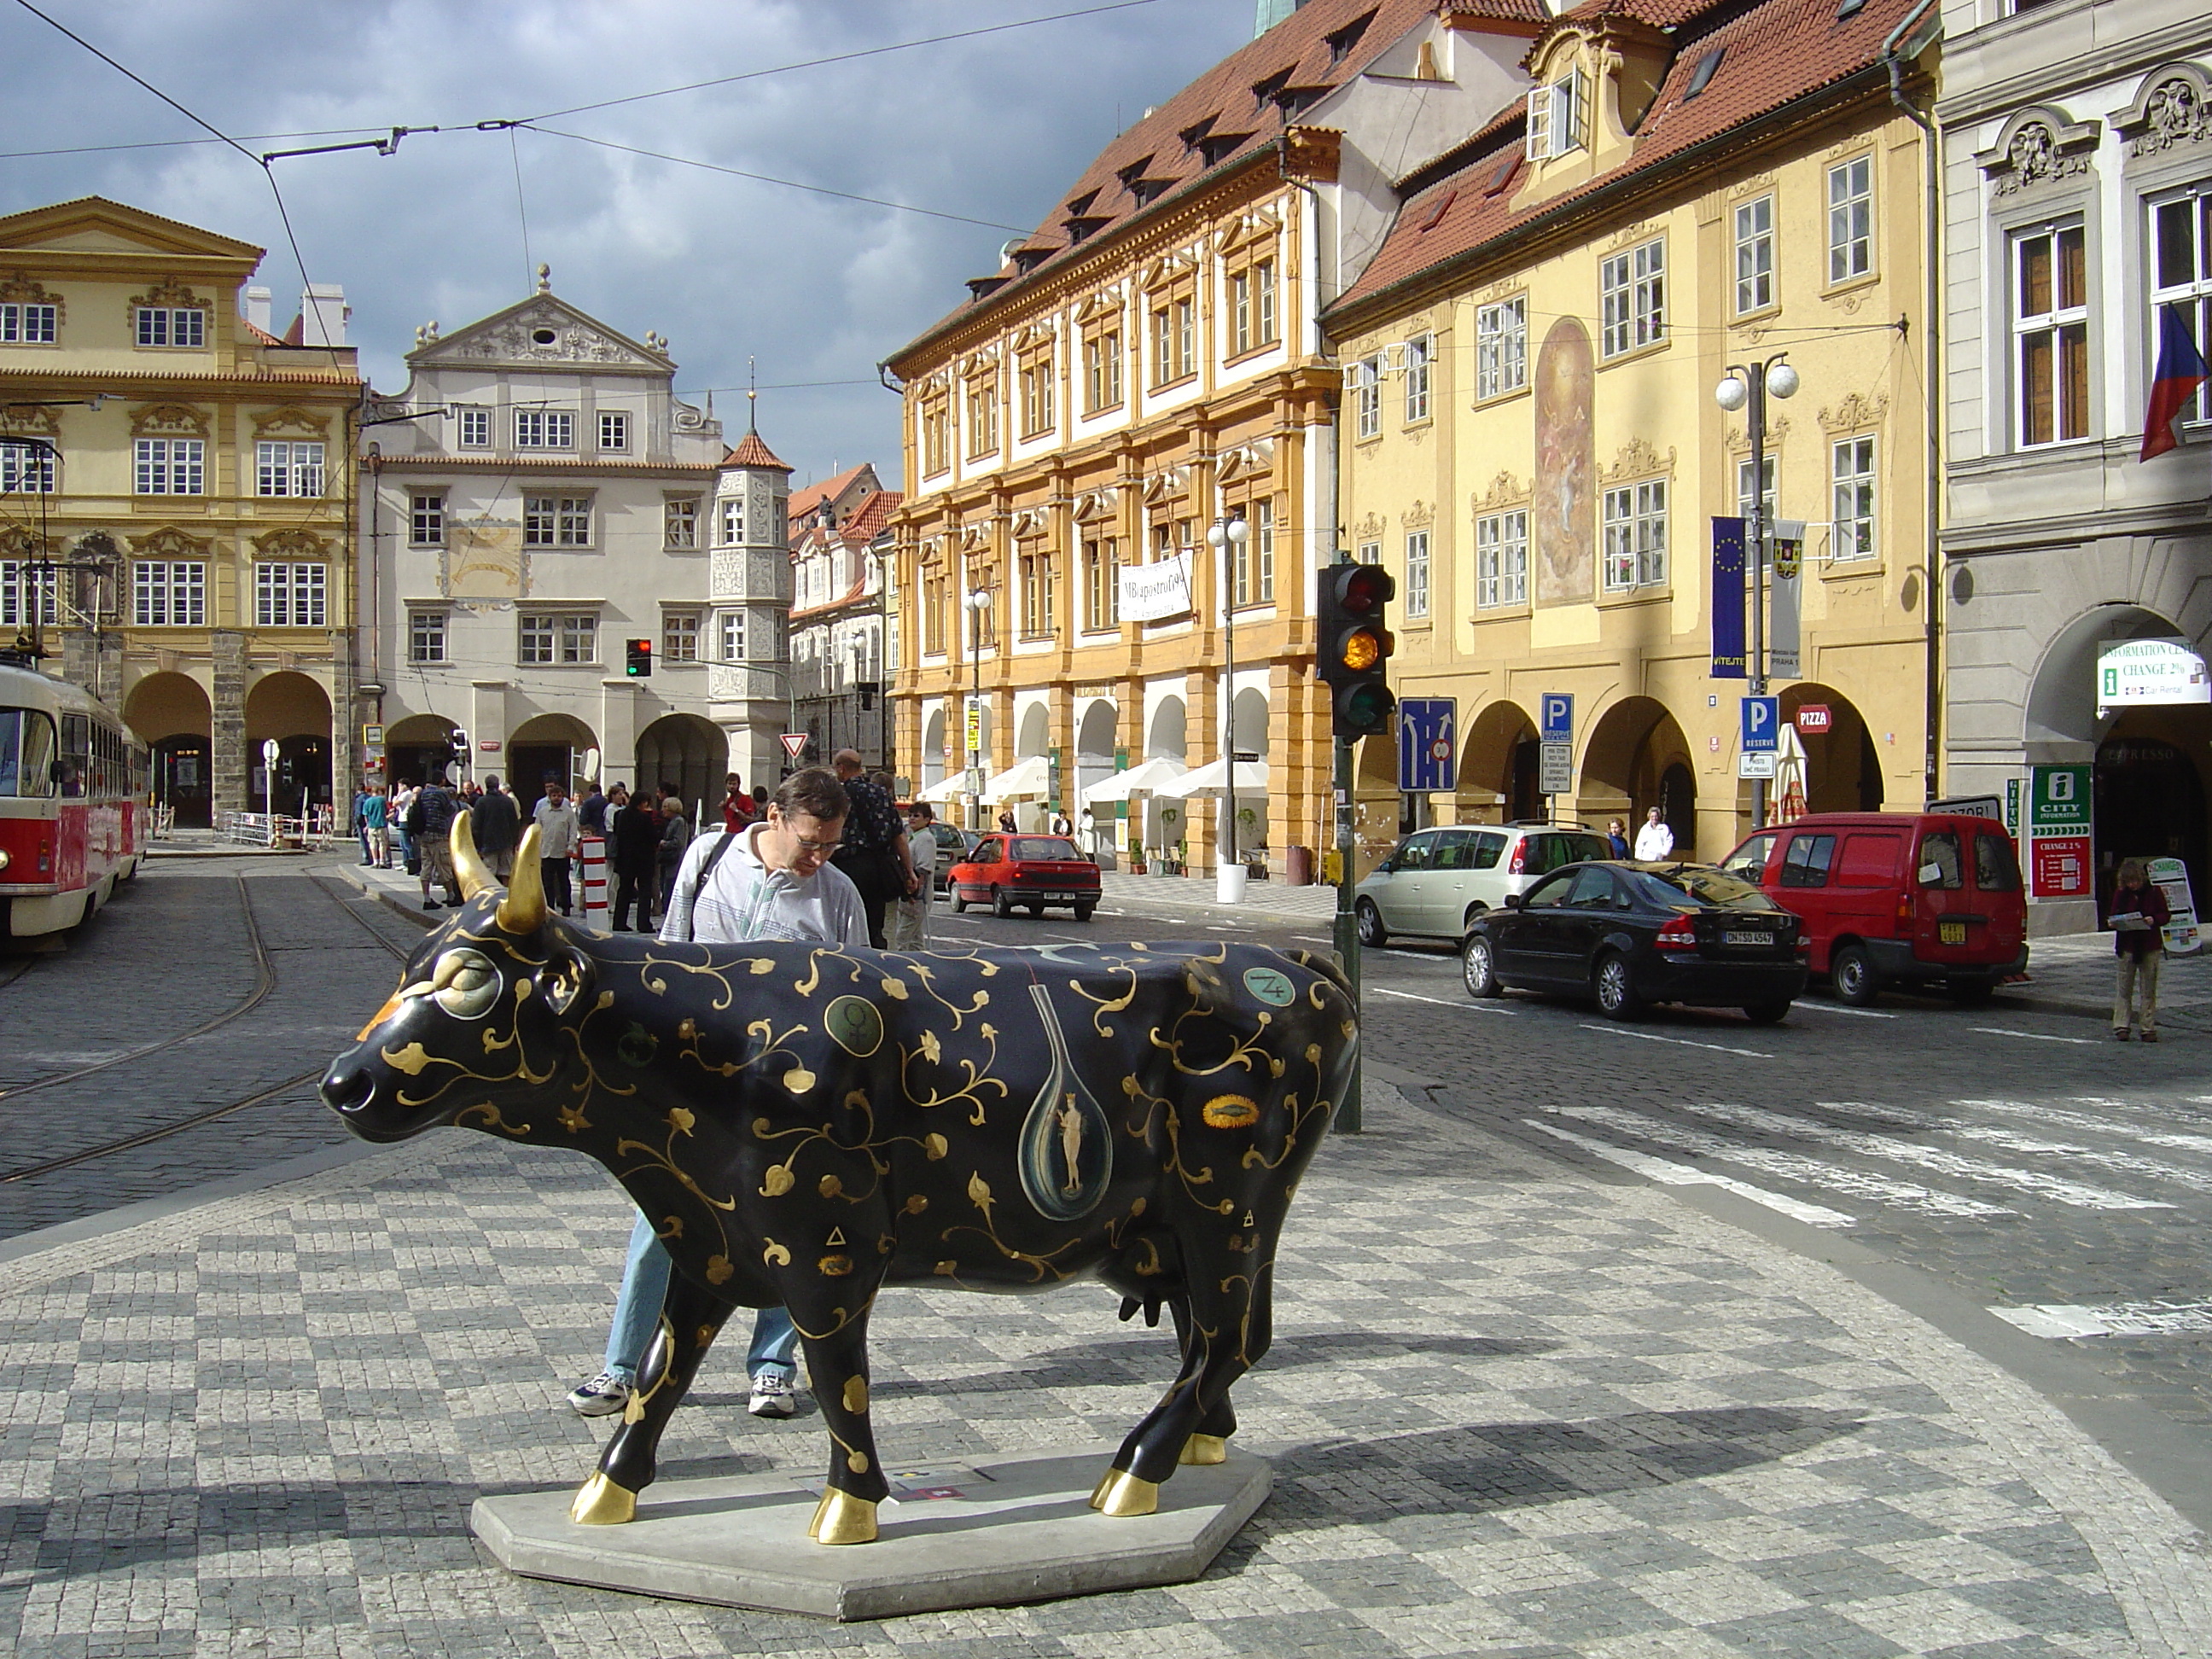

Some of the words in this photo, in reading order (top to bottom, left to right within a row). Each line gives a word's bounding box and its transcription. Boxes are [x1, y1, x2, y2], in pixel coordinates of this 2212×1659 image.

[2104, 644, 2166, 658] INFORMATION
[1772, 657, 1794, 666] PRAHA
[2122, 663, 2166, 676] CHANGE
[2145, 686, 2158, 695] Car
[2160, 685, 2183, 695] Rental
[1549, 699, 1567, 727] P
[1750, 701, 1768, 732] P
[1800, 712, 1826, 725] PIZZA
[2009, 780, 2017, 825] GIFTS
[2040, 804, 2081, 812] CITY
